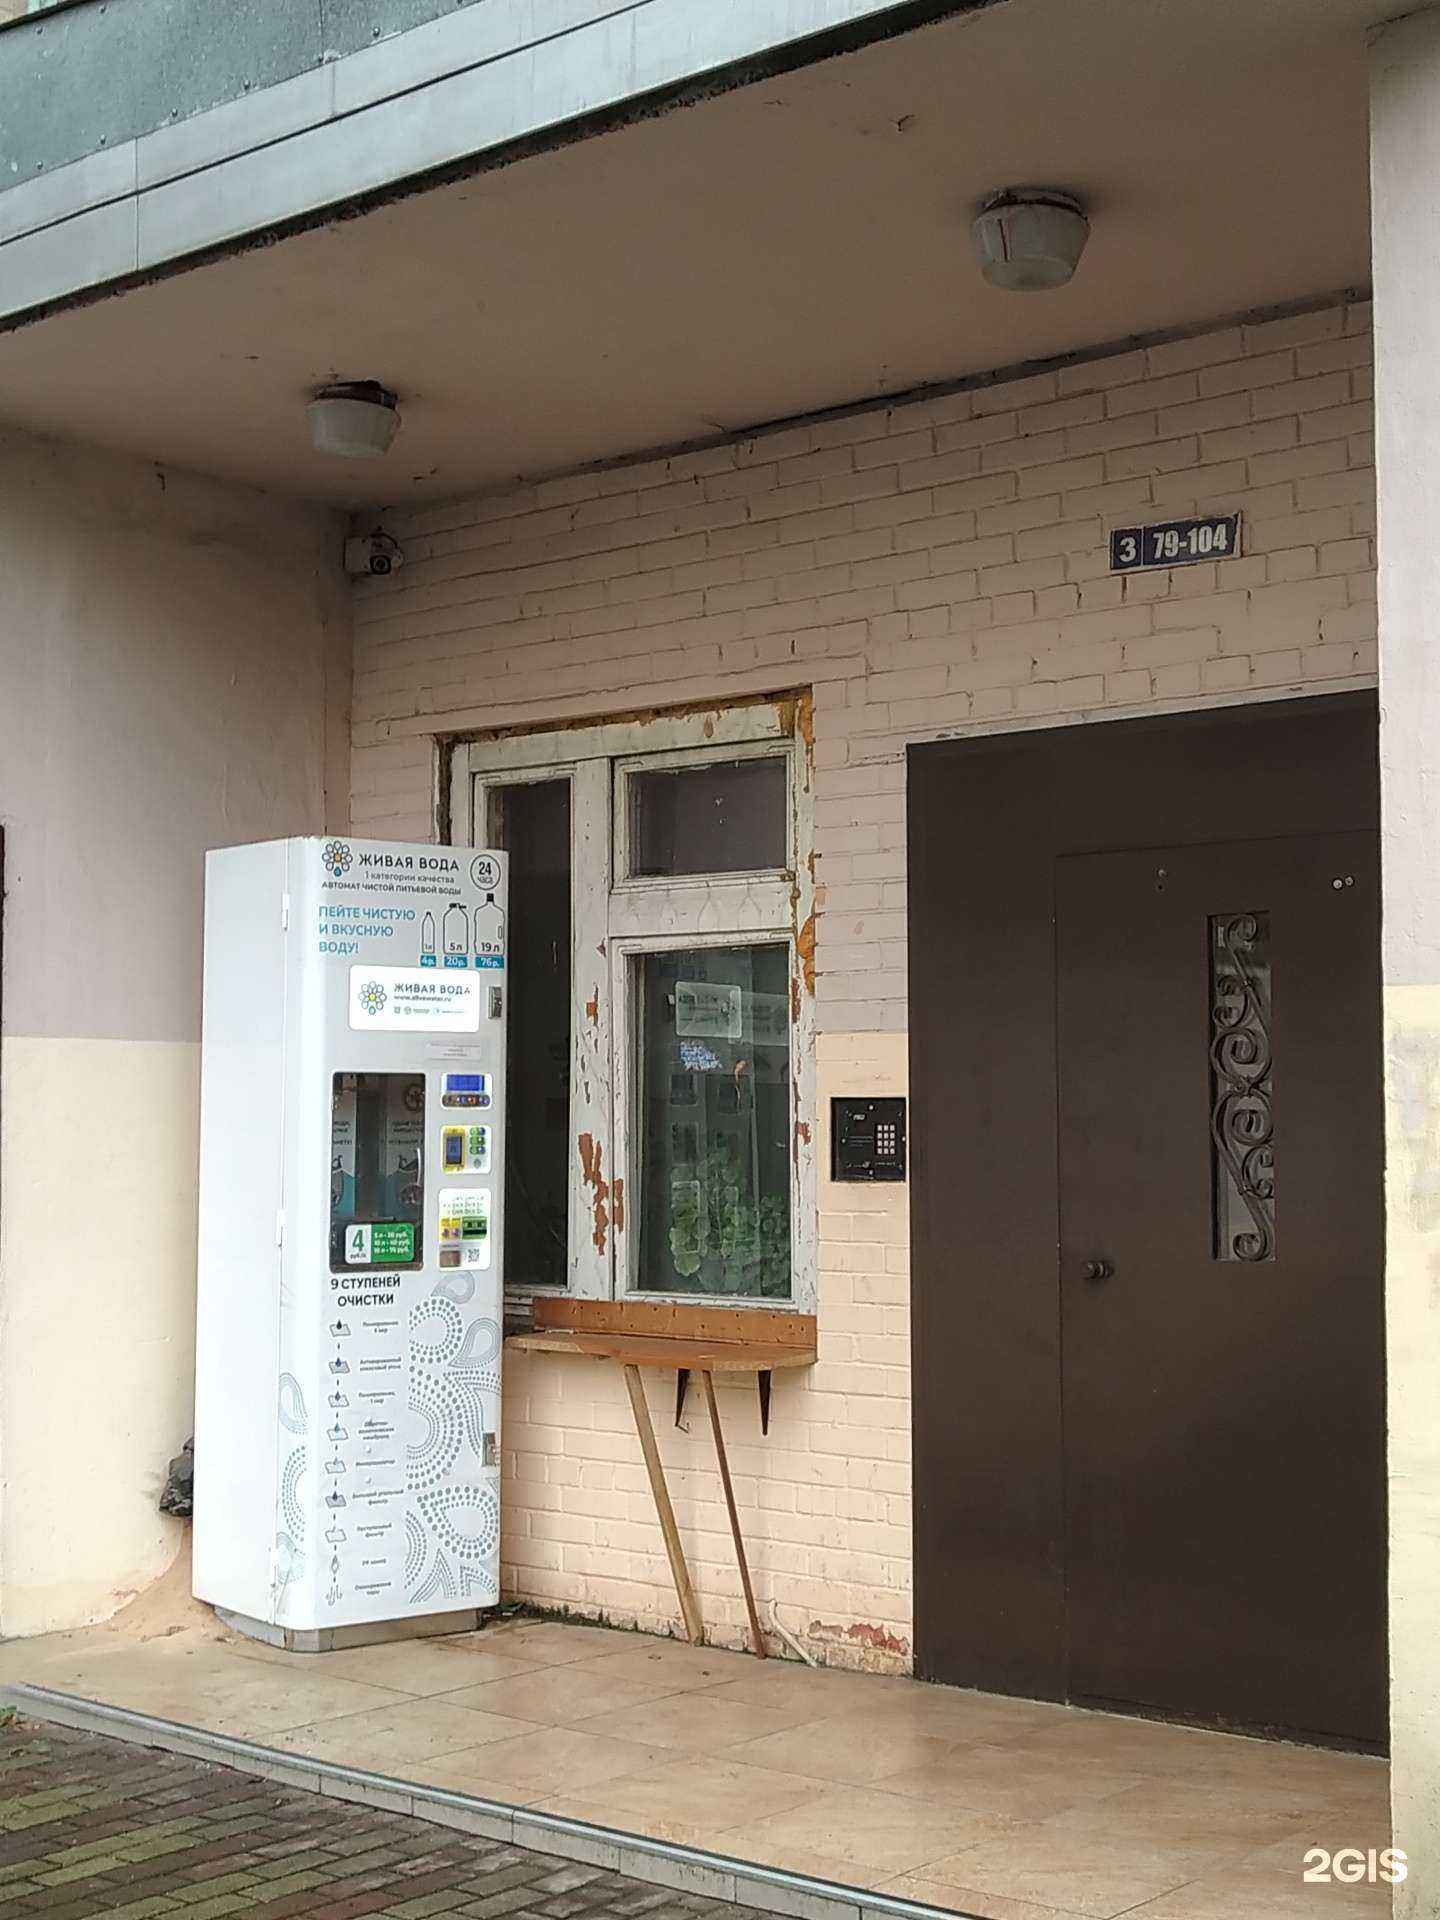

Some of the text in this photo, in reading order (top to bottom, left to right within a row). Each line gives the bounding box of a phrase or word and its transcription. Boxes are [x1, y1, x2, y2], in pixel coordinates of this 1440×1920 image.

[1119, 523, 1228, 563] 3 79-104
[359, 853, 460, 872] ЖИВАЯ ВОДА
[478, 861, 492, 876] 24
[318, 903, 416, 921] ПЕЙТЕ ЧИСТУЮ
[319, 923, 394, 937] И ВКУСНУЮ
[318, 941, 359, 955] ВОДУ!
[481, 942, 492, 952] 19
[393, 983, 471, 995] ЖИВАЯ ВОДА
[352, 1229, 365, 1252] 4
[330, 1273, 401, 1290] 9 СТУПЕНЕЙ
[337, 1294, 394, 1307] ОЧИСТКИ
